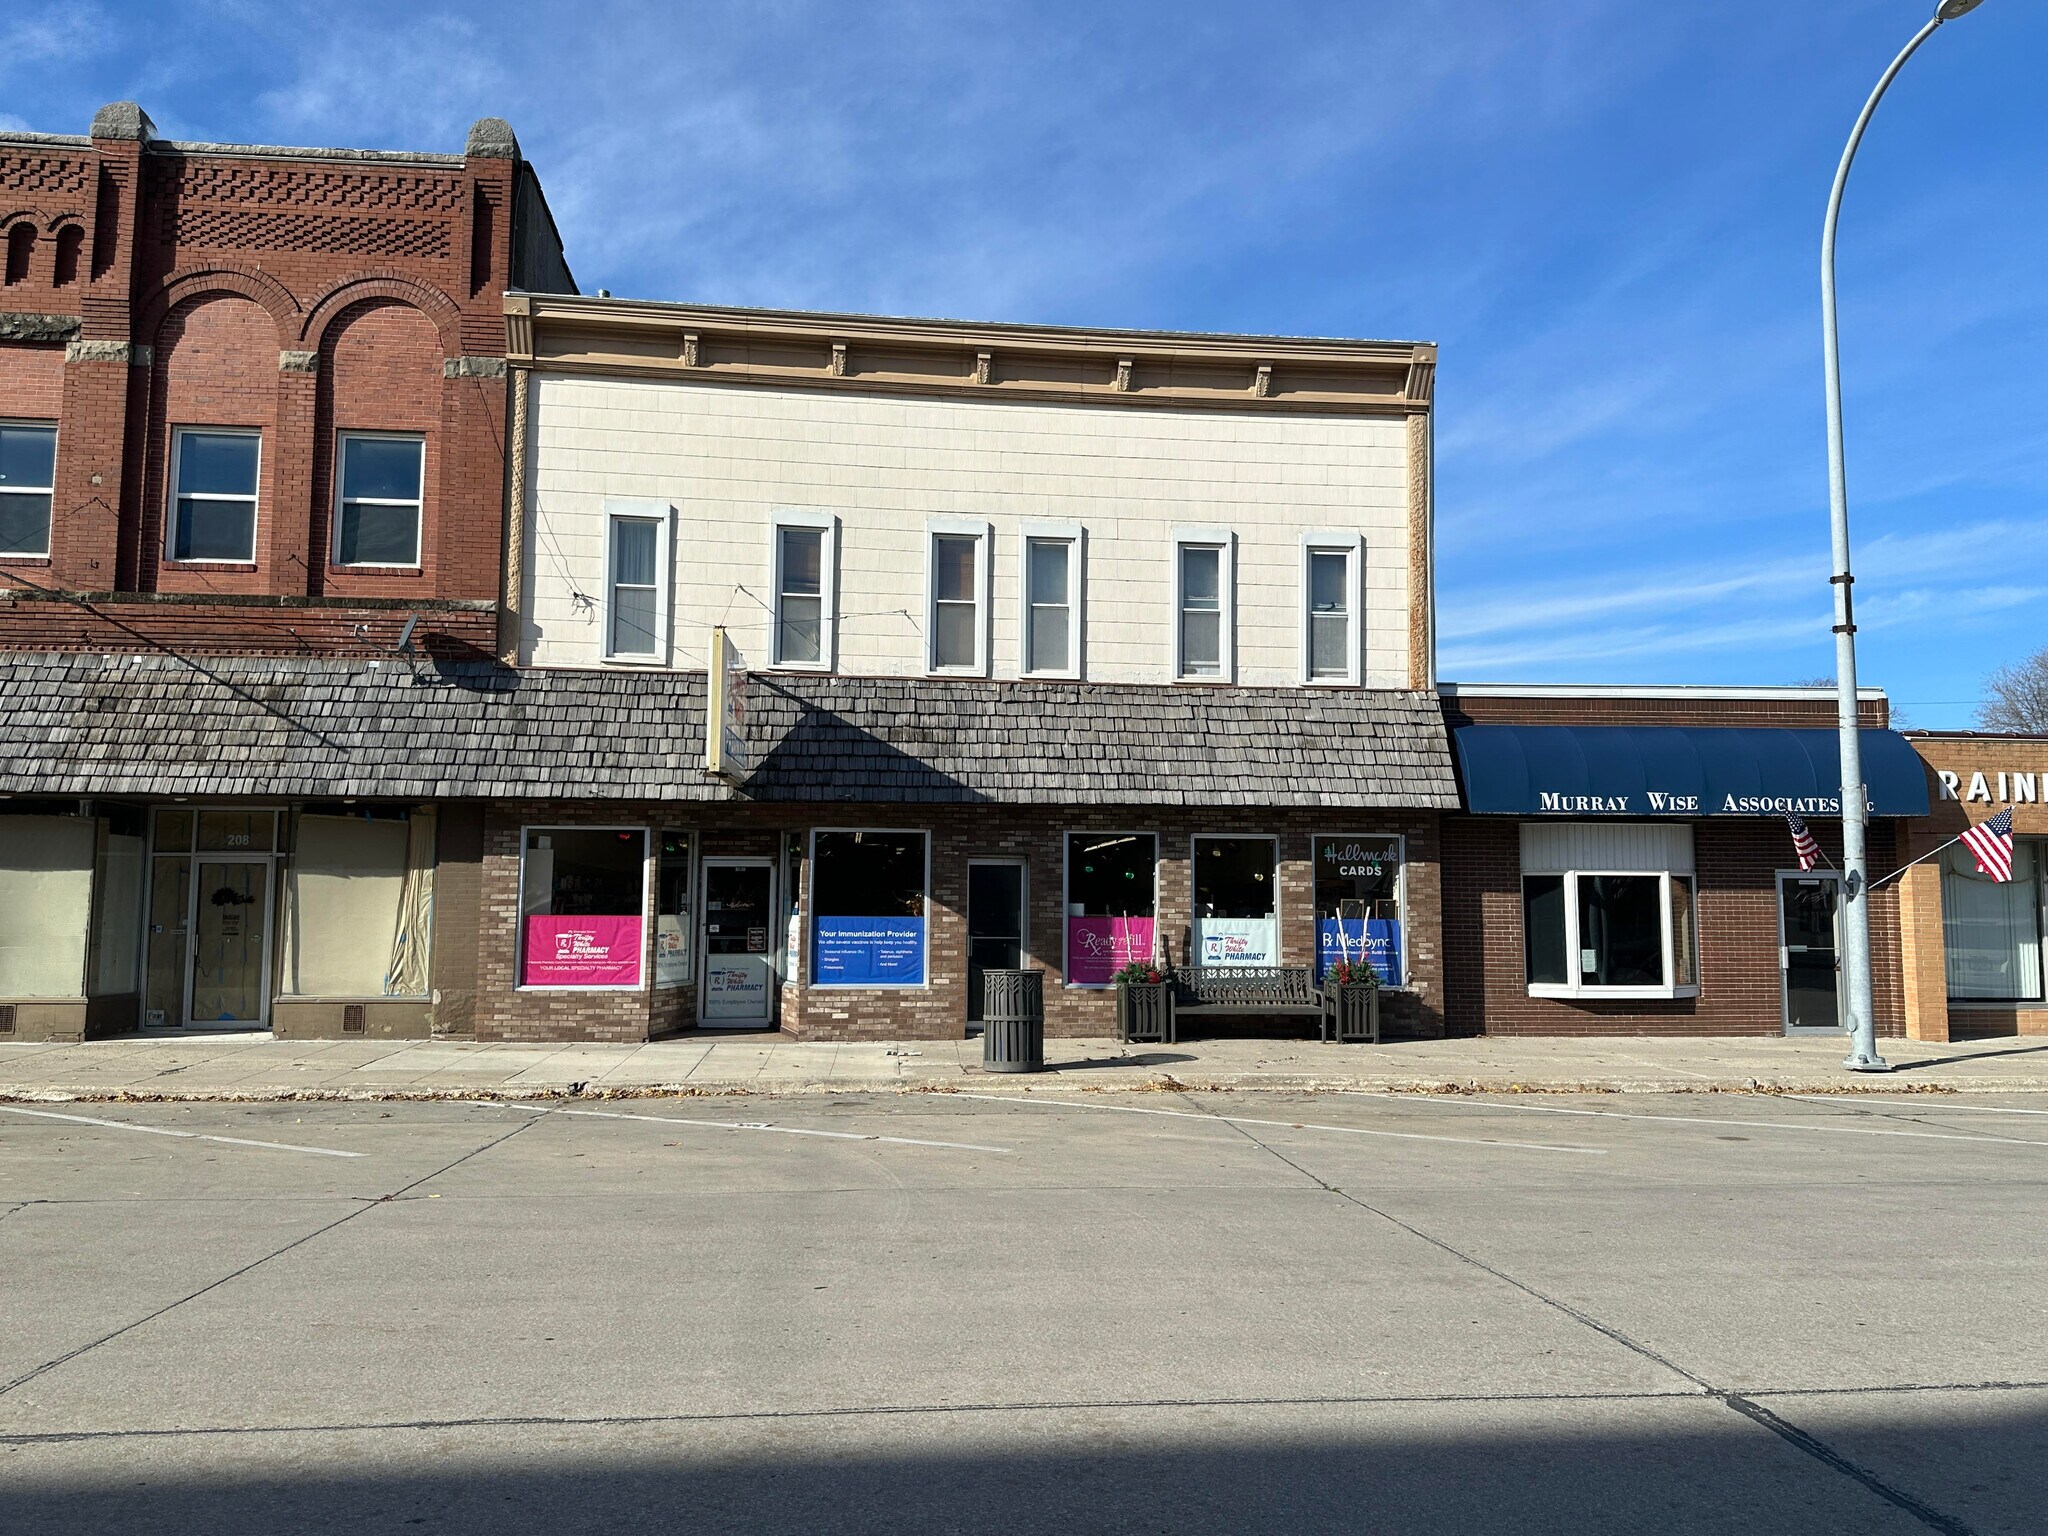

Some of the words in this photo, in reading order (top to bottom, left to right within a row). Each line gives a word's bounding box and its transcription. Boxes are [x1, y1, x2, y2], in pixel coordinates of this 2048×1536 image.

[1539, 792, 1628, 811] MURRAY
[1647, 791, 1698, 811] WISE
[1722, 793, 1839, 812] ASSOCIATES
[228, 835, 250, 845] 208
[1324, 843, 1397, 864] Hallmark
[1340, 866, 1382, 876] CARDS
[1224, 937, 1248, 946] Thrifty
[1336, 933, 1391, 949] MedSync
